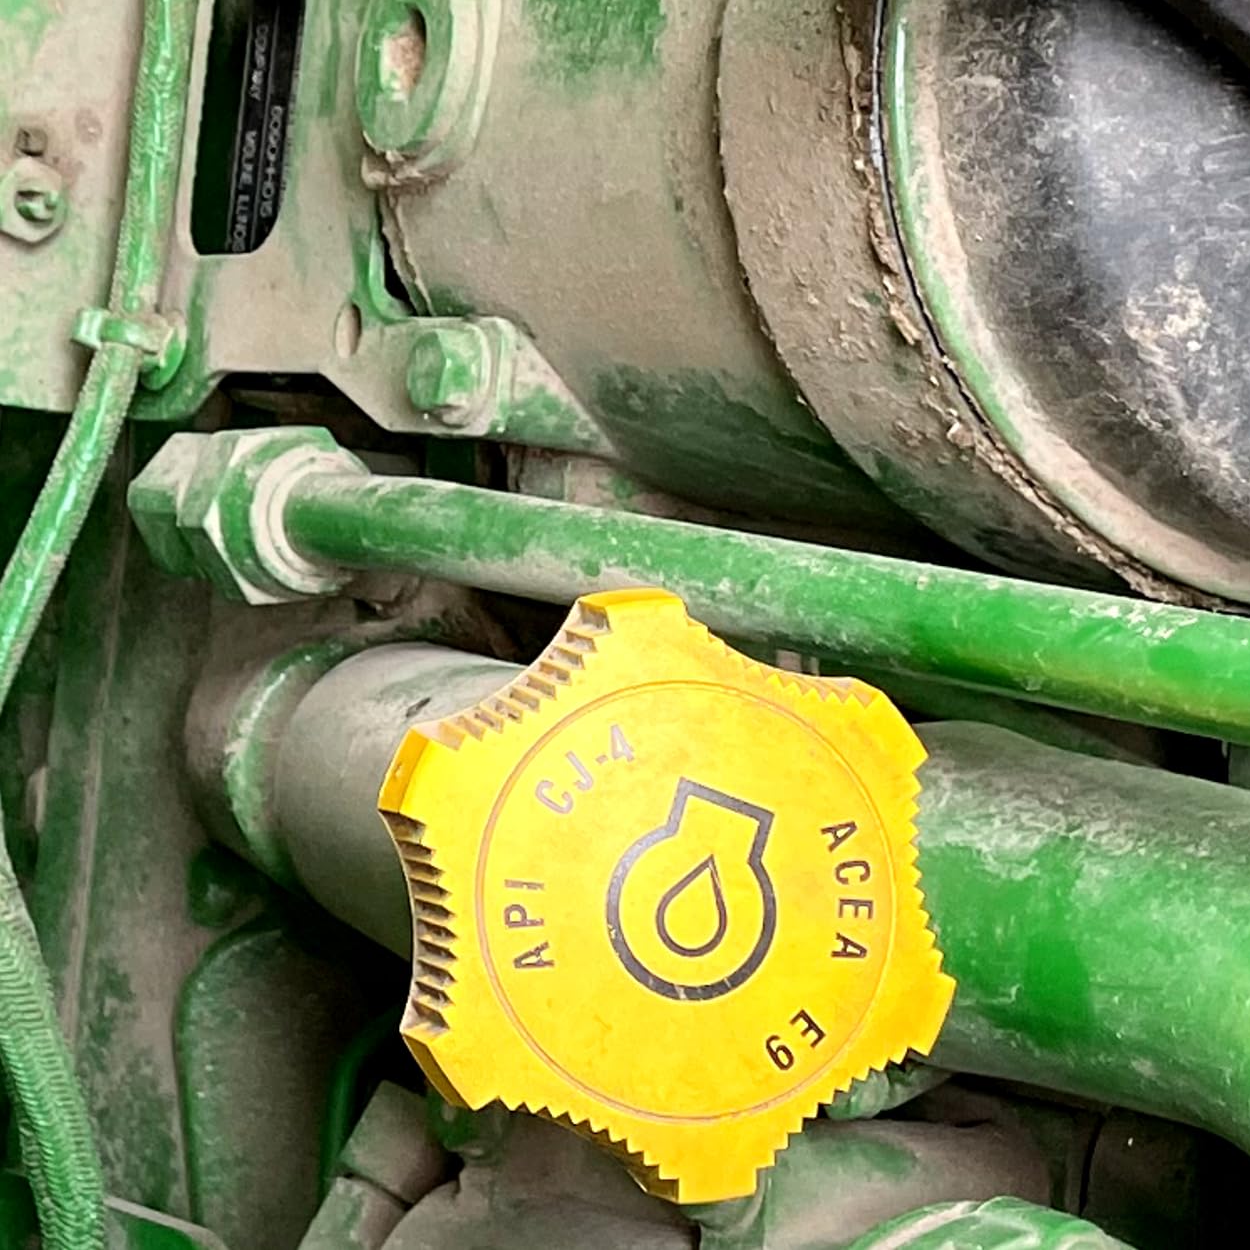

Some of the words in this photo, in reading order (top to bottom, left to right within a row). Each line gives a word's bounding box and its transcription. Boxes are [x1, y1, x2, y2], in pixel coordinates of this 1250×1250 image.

[502, 878, 555, 971] API
[534, 723, 636, 816] CJ-4
[820, 819, 875, 961] ACEA
